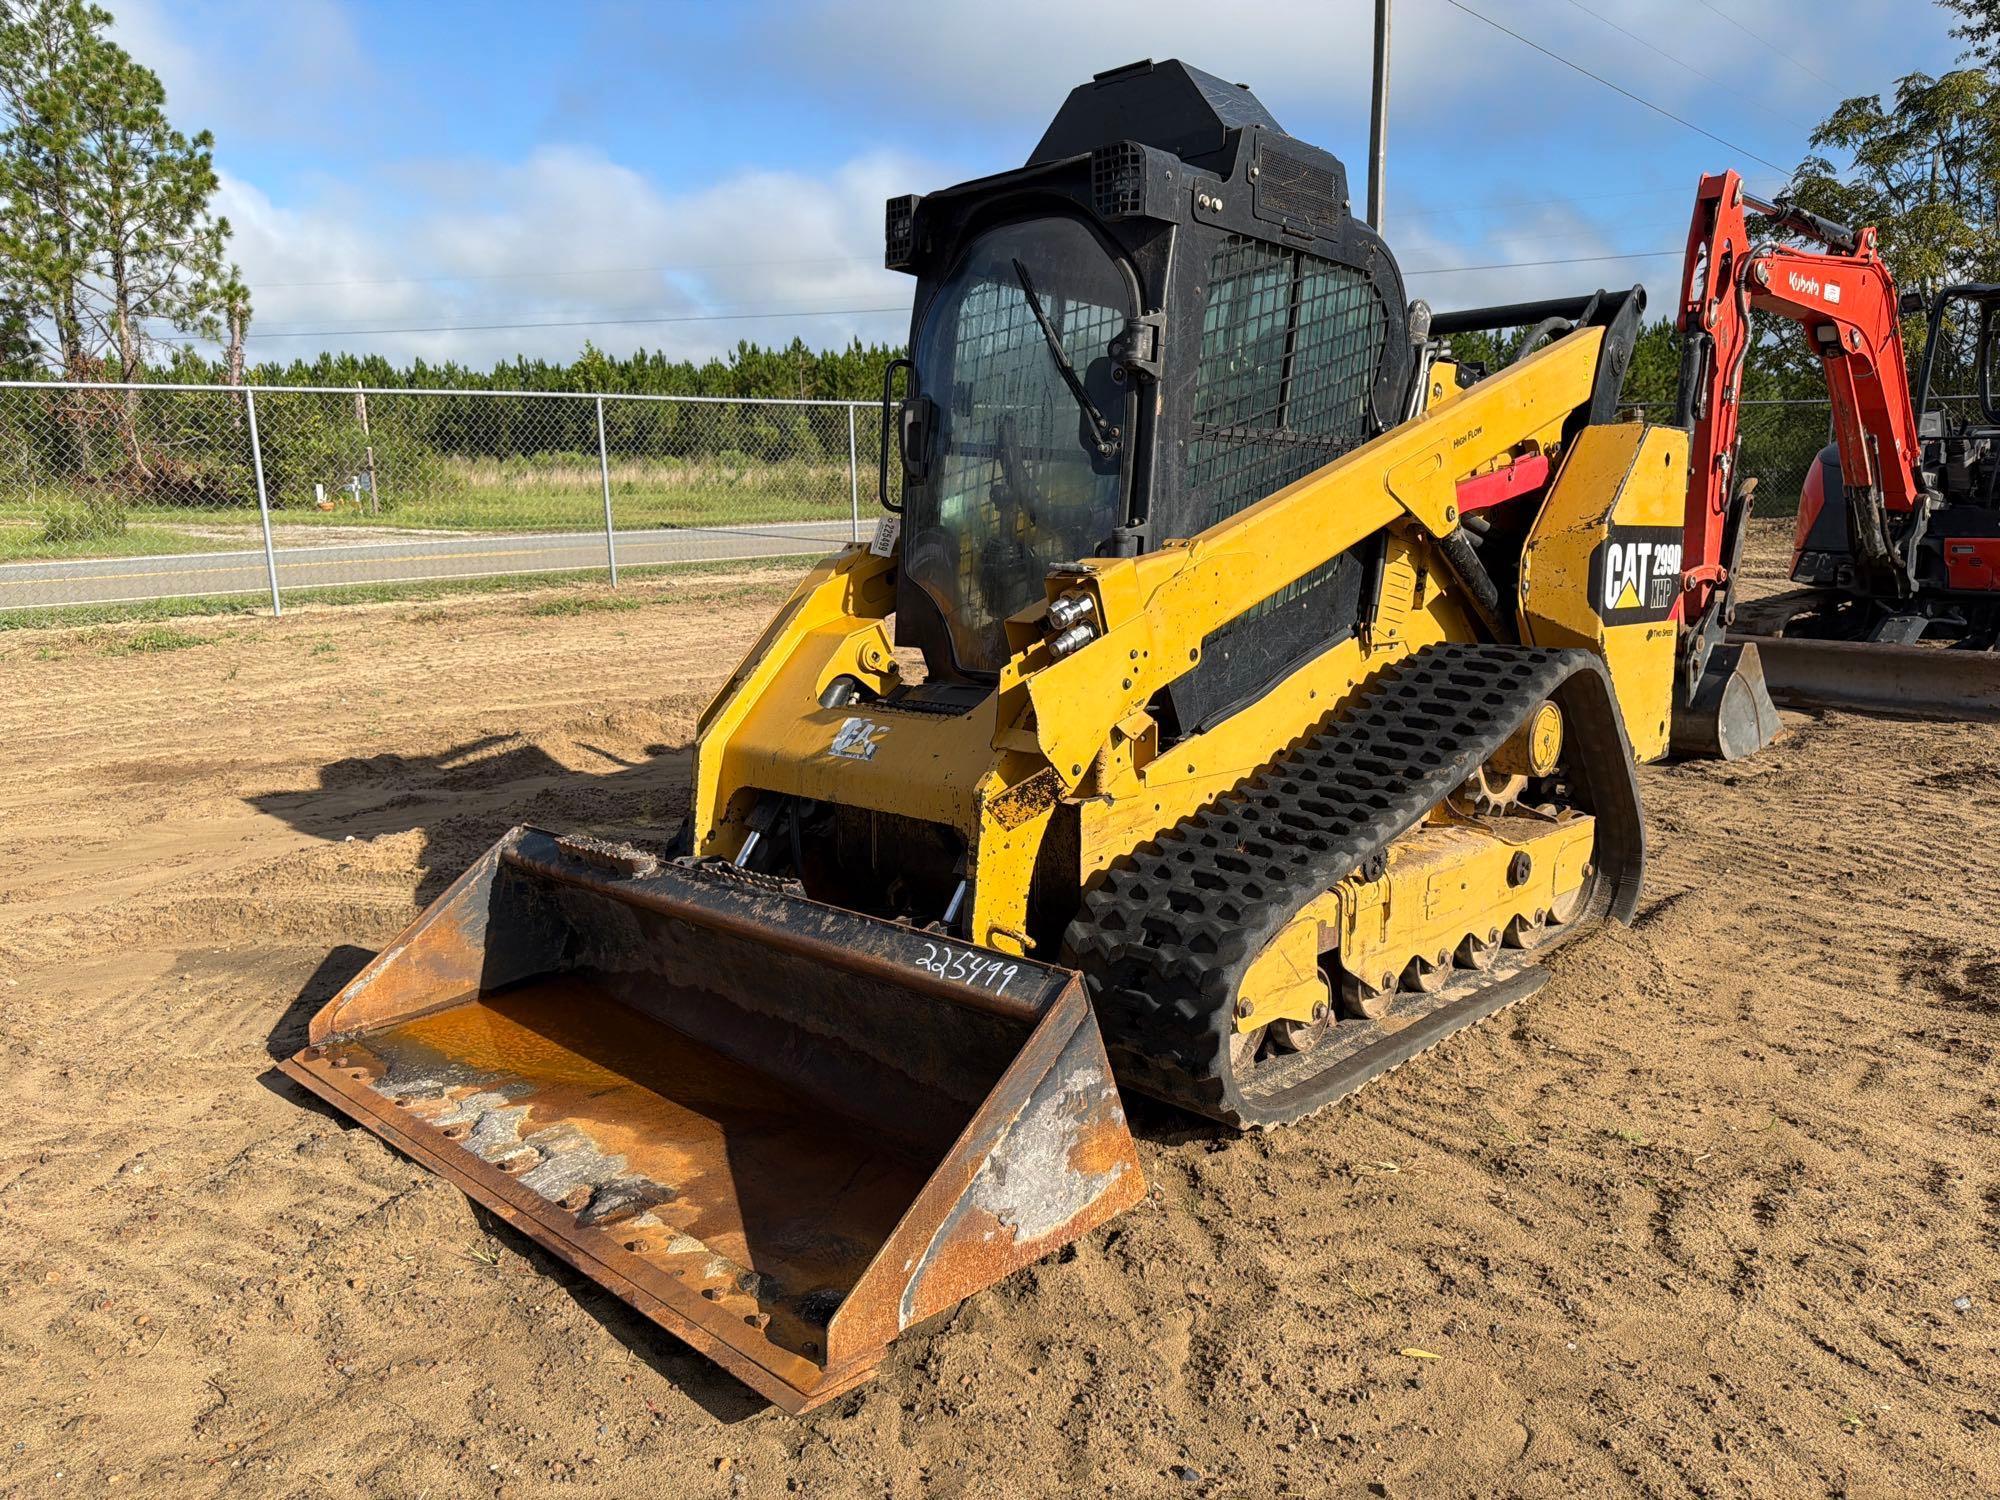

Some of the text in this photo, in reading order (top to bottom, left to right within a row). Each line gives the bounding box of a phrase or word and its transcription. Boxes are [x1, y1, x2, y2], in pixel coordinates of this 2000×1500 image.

[1788, 271, 1820, 297] Kubota
[878, 523, 895, 551] 225499
[1604, 542, 1682, 610] CAT 299D
[1650, 578, 1672, 609] XHP
[915, 942, 1019, 997] 225499
